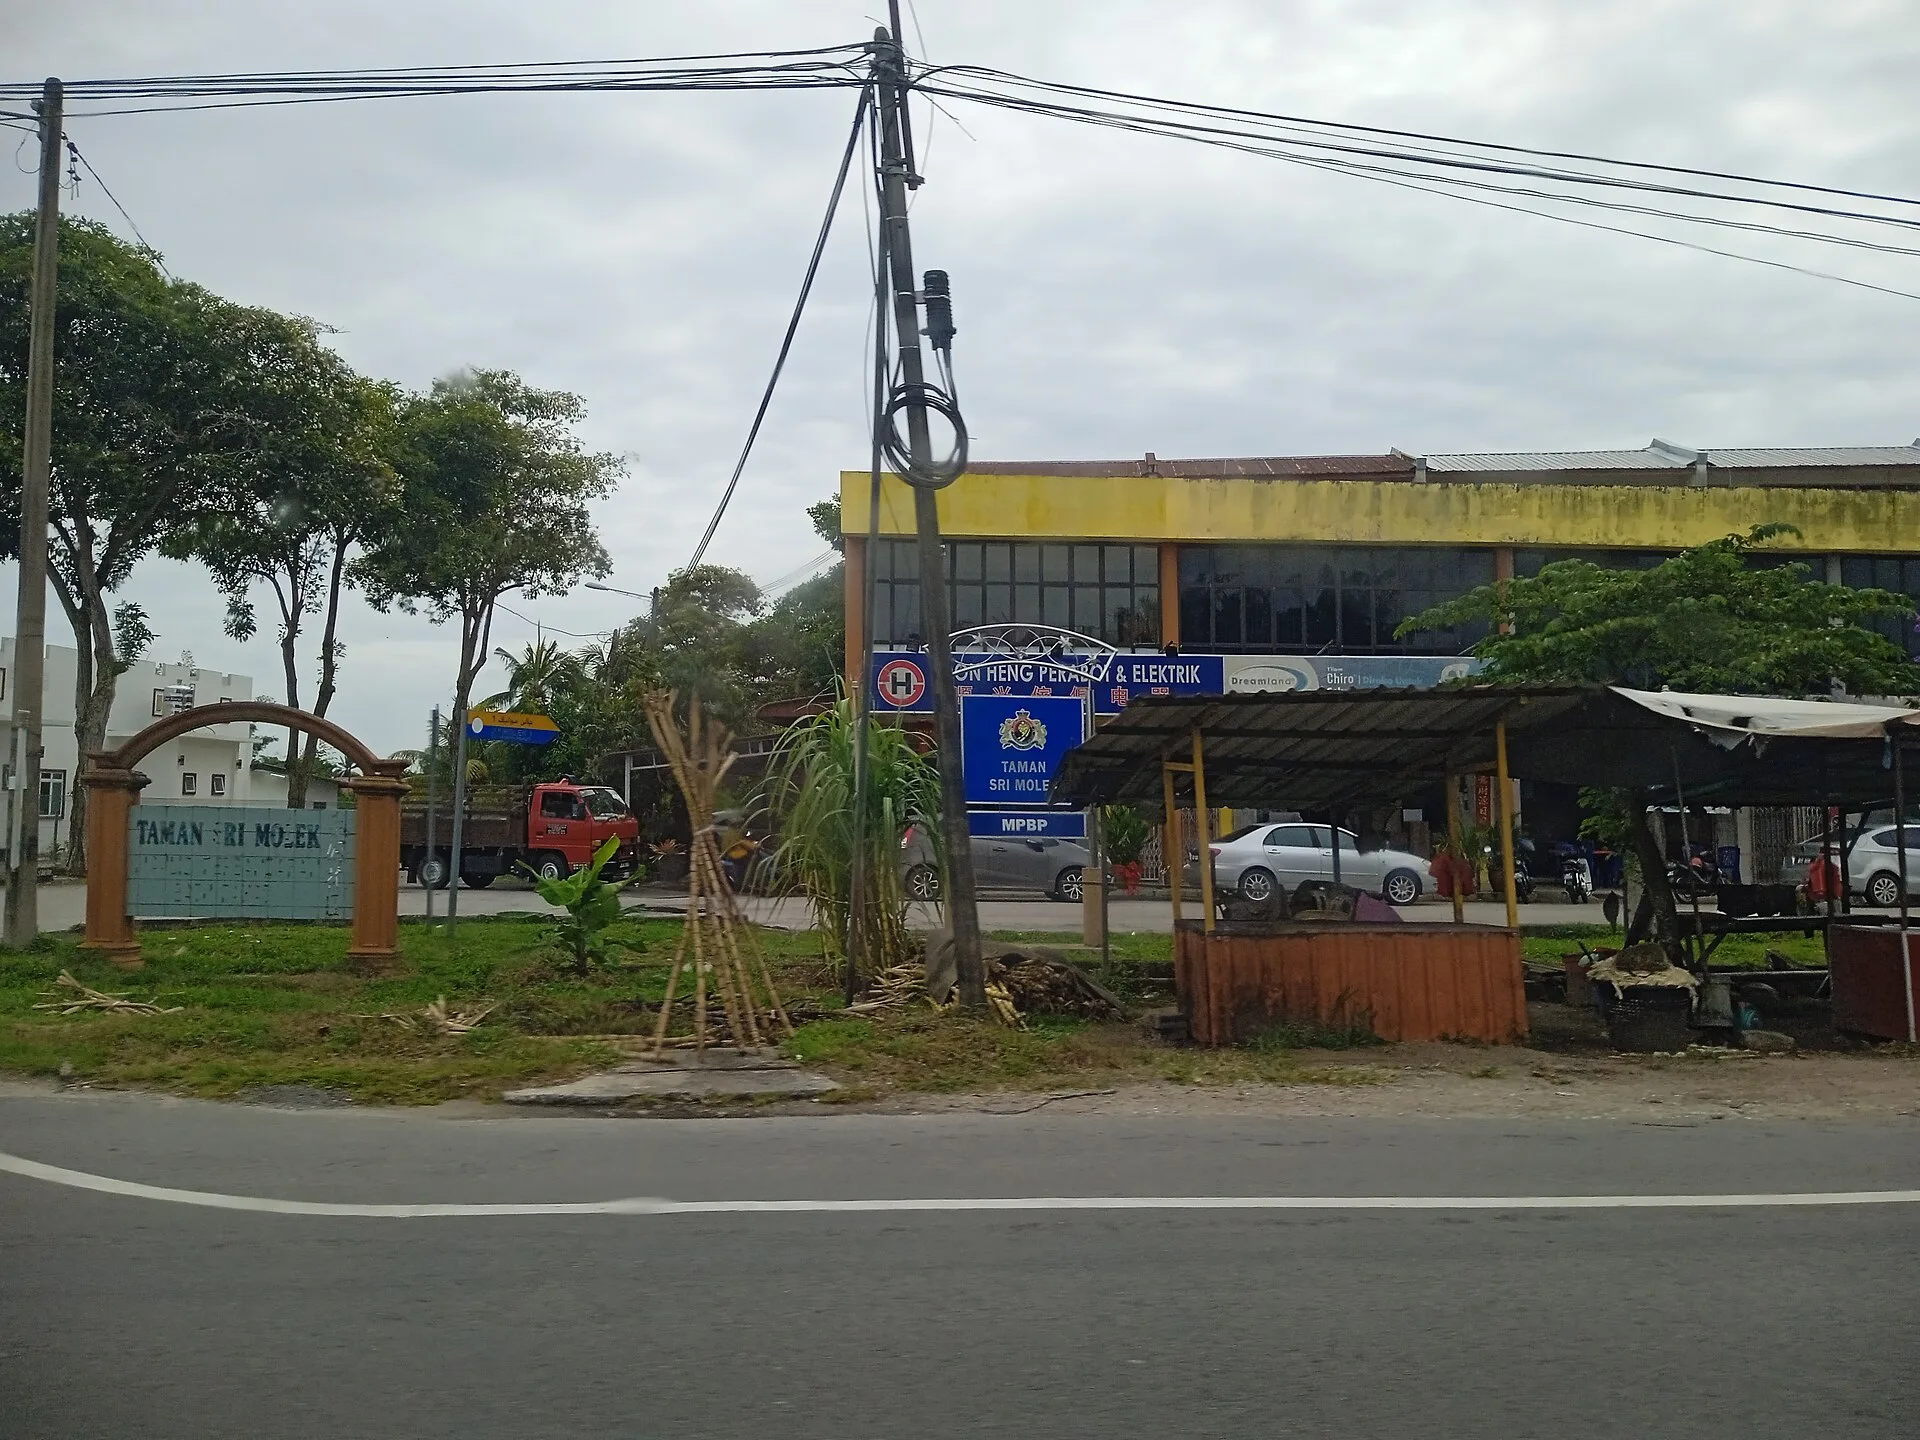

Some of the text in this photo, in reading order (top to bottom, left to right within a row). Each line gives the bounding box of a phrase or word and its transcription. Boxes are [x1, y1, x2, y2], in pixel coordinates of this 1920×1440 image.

[954, 663, 981, 682] ON
[987, 664, 1034, 683] HENG
[1116, 665, 1128, 683] &
[1132, 664, 1201, 684] ELEKTRIK
[1327, 672, 1354, 685] Chiro
[1231, 676, 1292, 686] Dreamland
[1001, 761, 1046, 773] TAMAN
[989, 778, 1050, 792] SRI MOLE
[1001, 818, 1048, 832] MPBP
[136, 819, 204, 846] TAMAN
